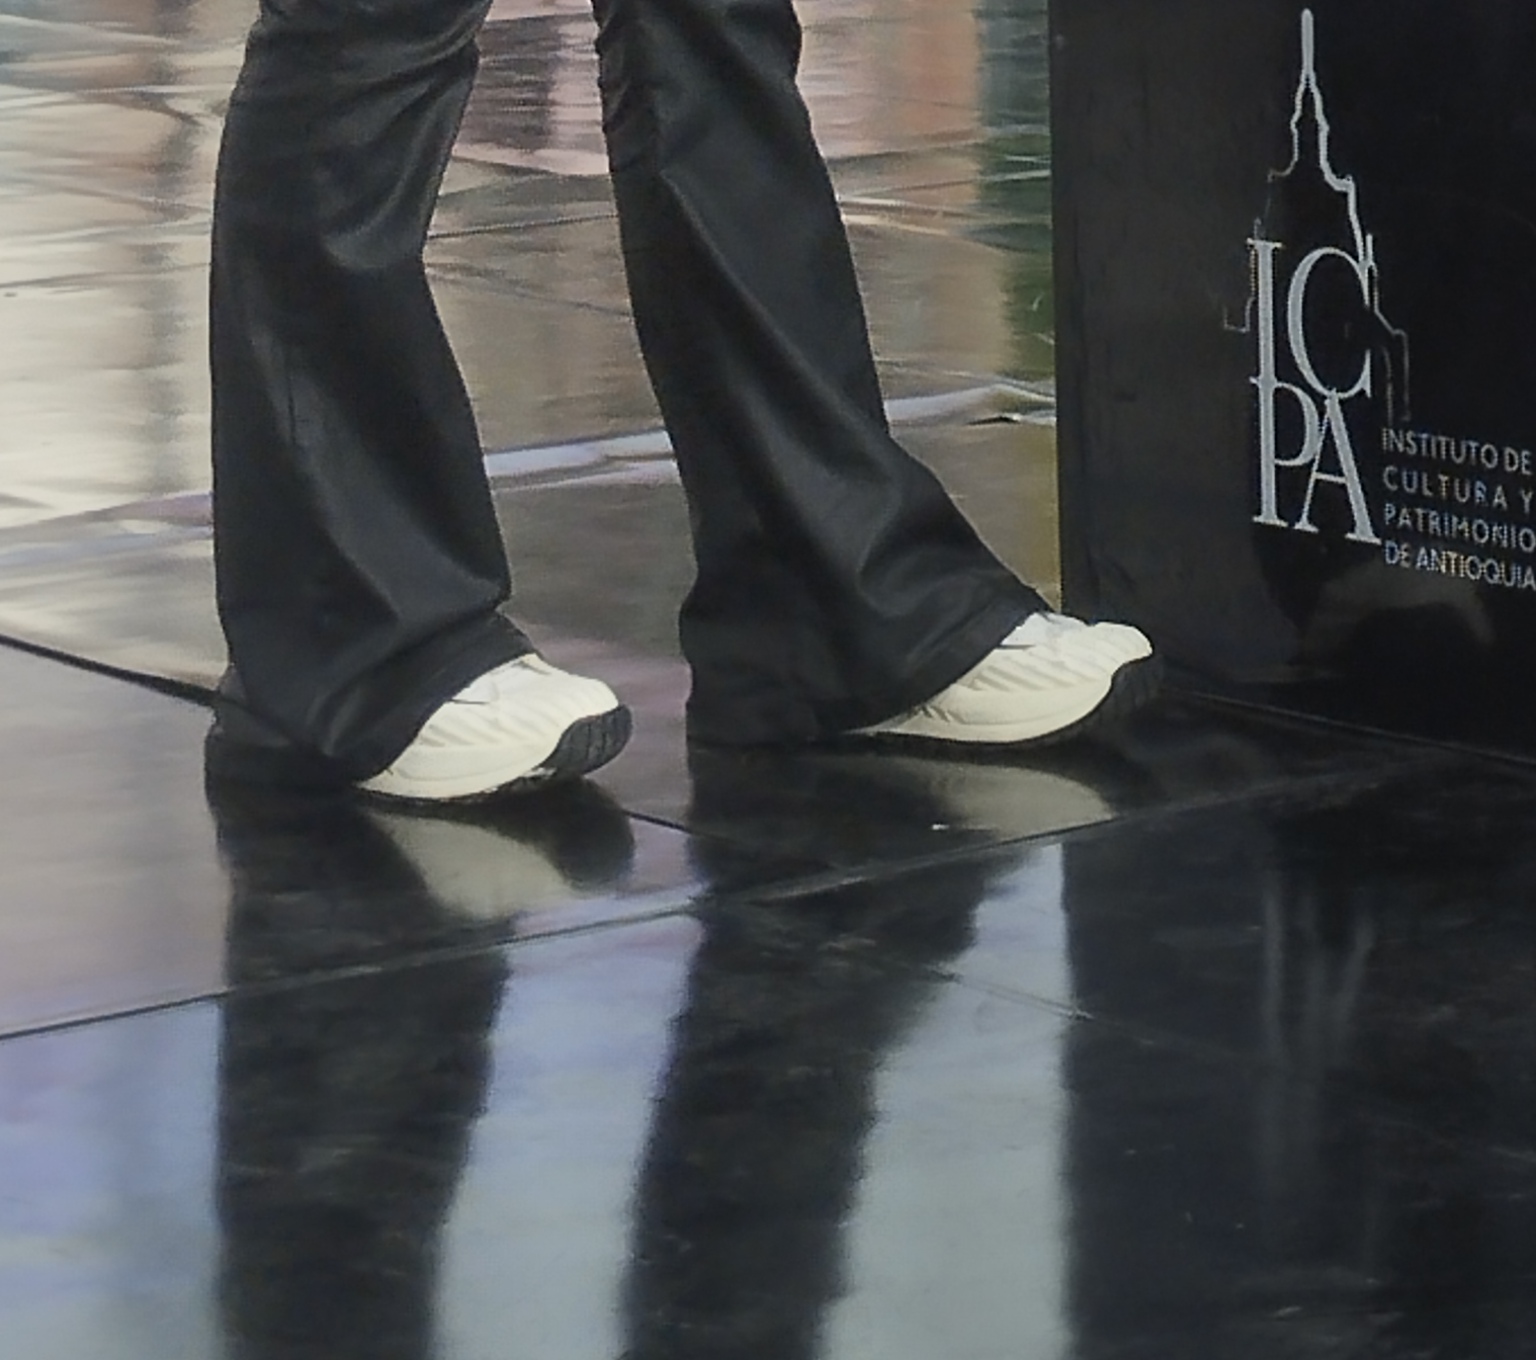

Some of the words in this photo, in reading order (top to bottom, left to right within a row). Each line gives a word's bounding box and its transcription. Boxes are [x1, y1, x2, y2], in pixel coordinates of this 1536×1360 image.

[1382, 428, 1499, 469] INSTITUTO
[1504, 447, 1533, 475] DE
[1383, 466, 1508, 510] CULTURA
[1519, 488, 1534, 514] Y
[1384, 503, 1536, 553] PATRIMONIO
[1384, 540, 1412, 568] DE
